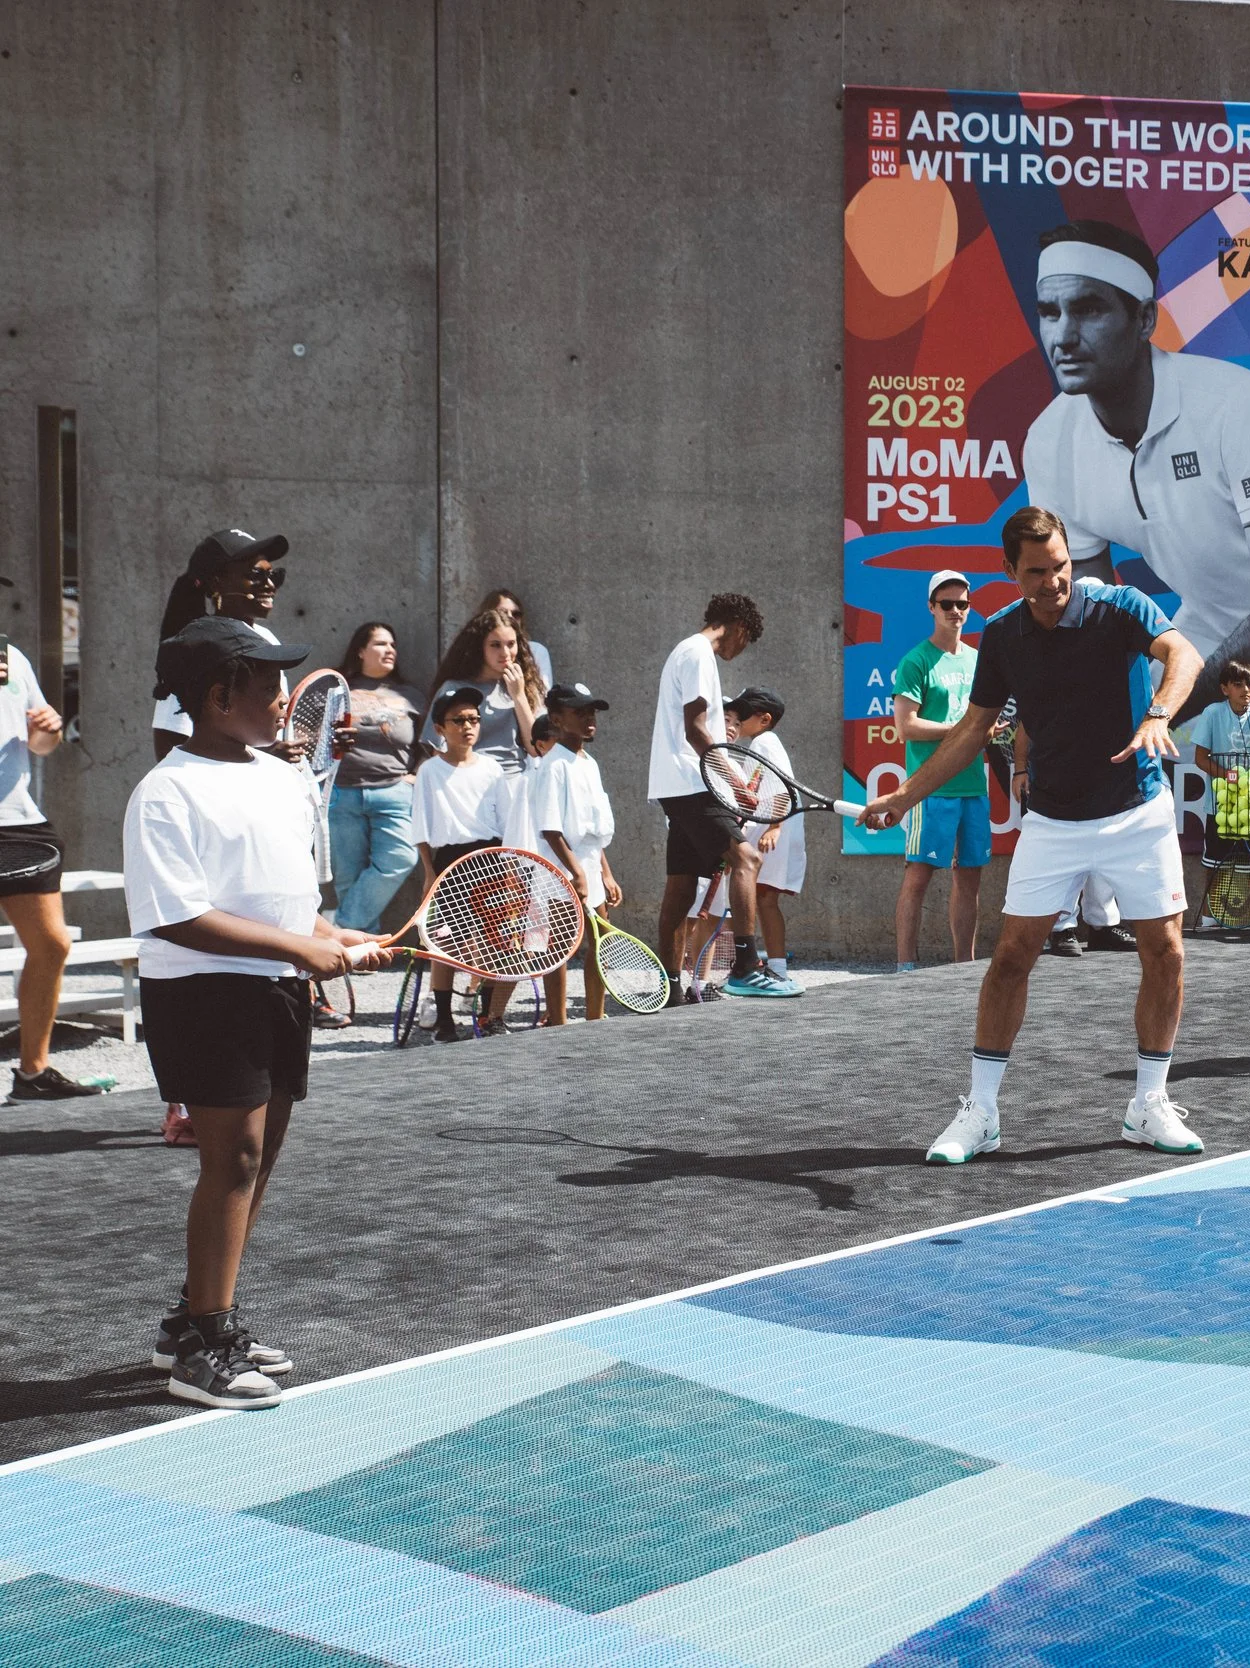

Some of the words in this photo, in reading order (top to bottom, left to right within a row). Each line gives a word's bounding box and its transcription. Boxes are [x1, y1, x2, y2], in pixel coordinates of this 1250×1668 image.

[907, 110, 1074, 147] AROUND
[1084, 117, 1162, 151] THE
[906, 149, 1009, 184] WITH
[1020, 154, 1149, 190] ROGER
[868, 375, 940, 391] AUGUST
[944, 377, 965, 391] 02
[867, 393, 965, 429] 2023
[867, 437, 1017, 479] MoMA
[867, 482, 957, 523] PS1
